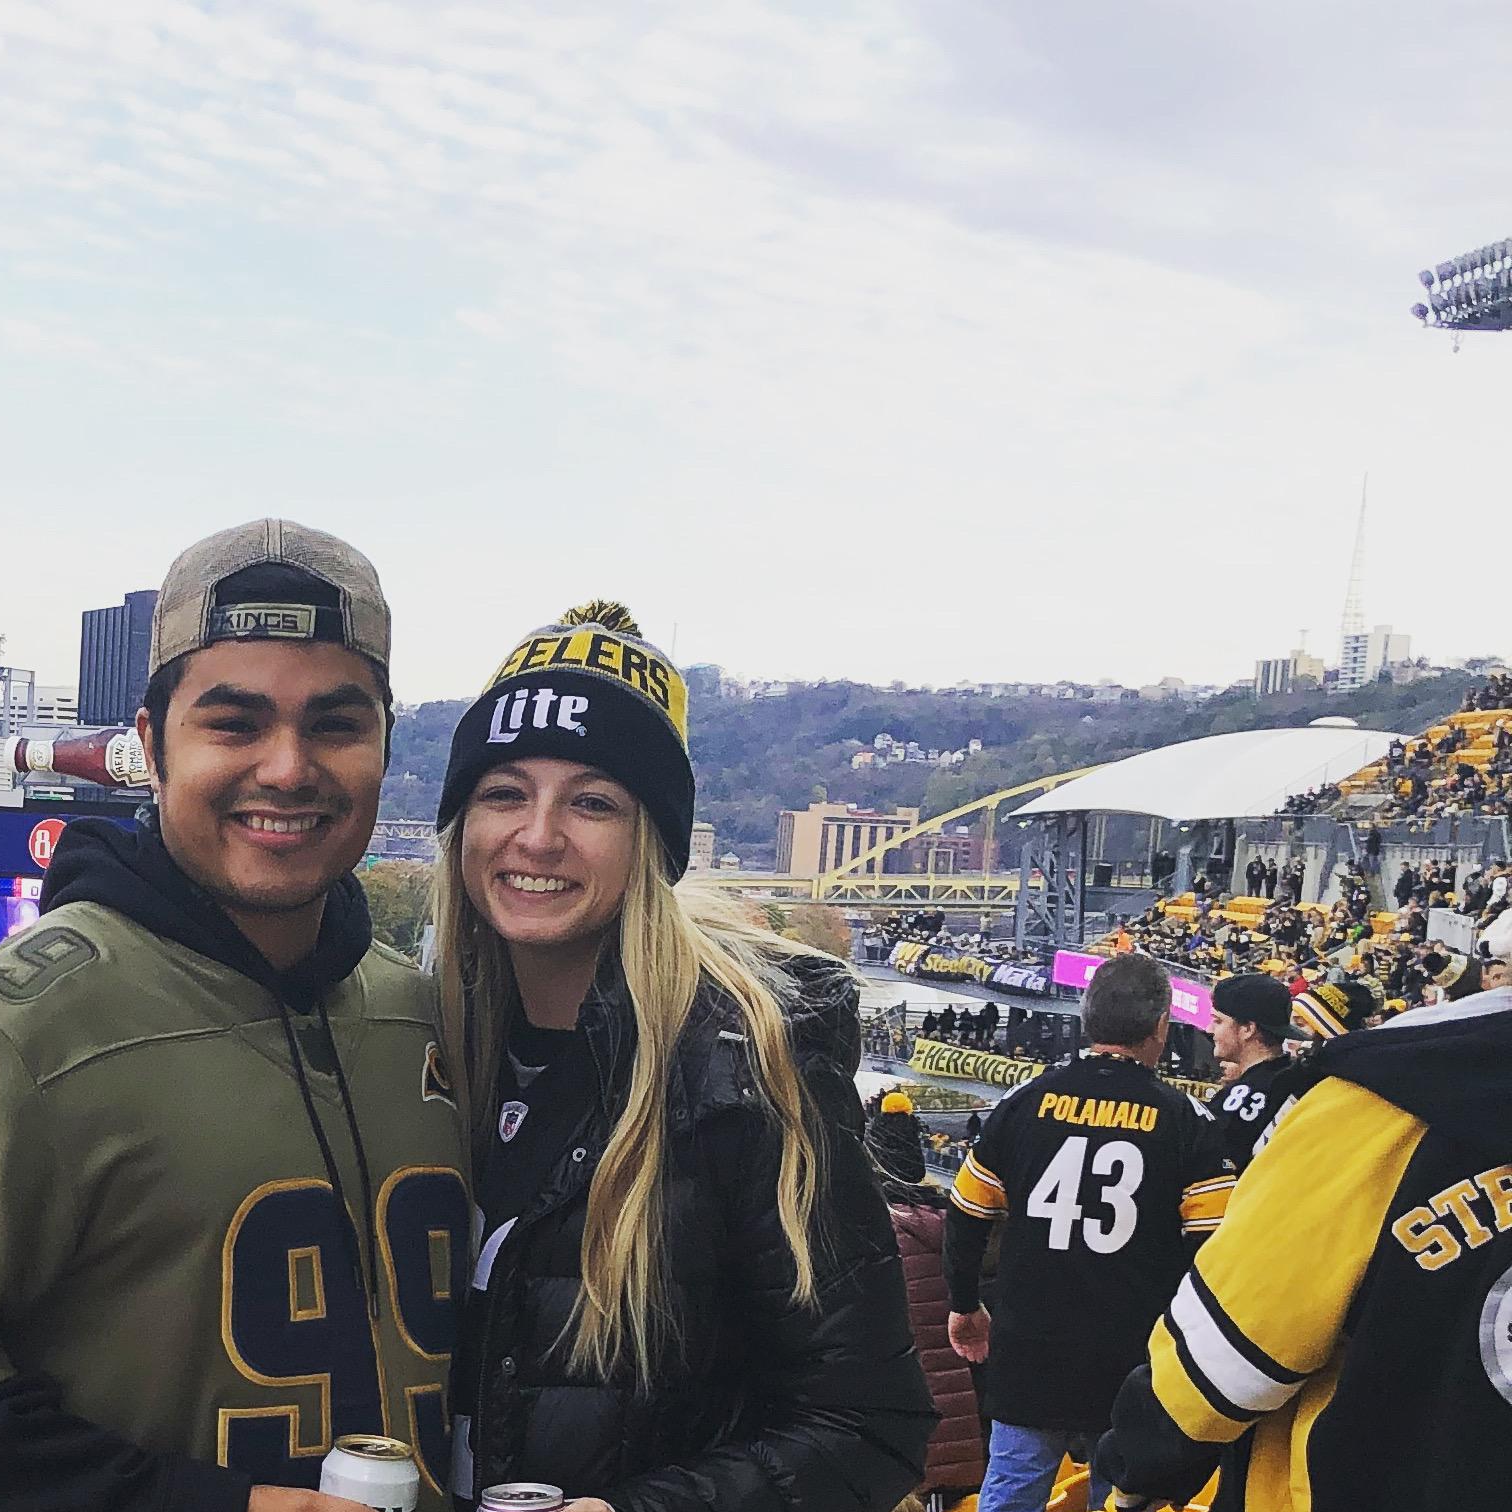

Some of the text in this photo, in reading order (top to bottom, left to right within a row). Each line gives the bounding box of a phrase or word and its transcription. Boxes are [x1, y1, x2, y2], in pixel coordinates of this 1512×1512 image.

[486, 688, 589, 744] Lite
[1037, 1092, 1159, 1132] POLAMALU
[1222, 1084, 1267, 1122] 83
[1026, 1135, 1145, 1255] 43
